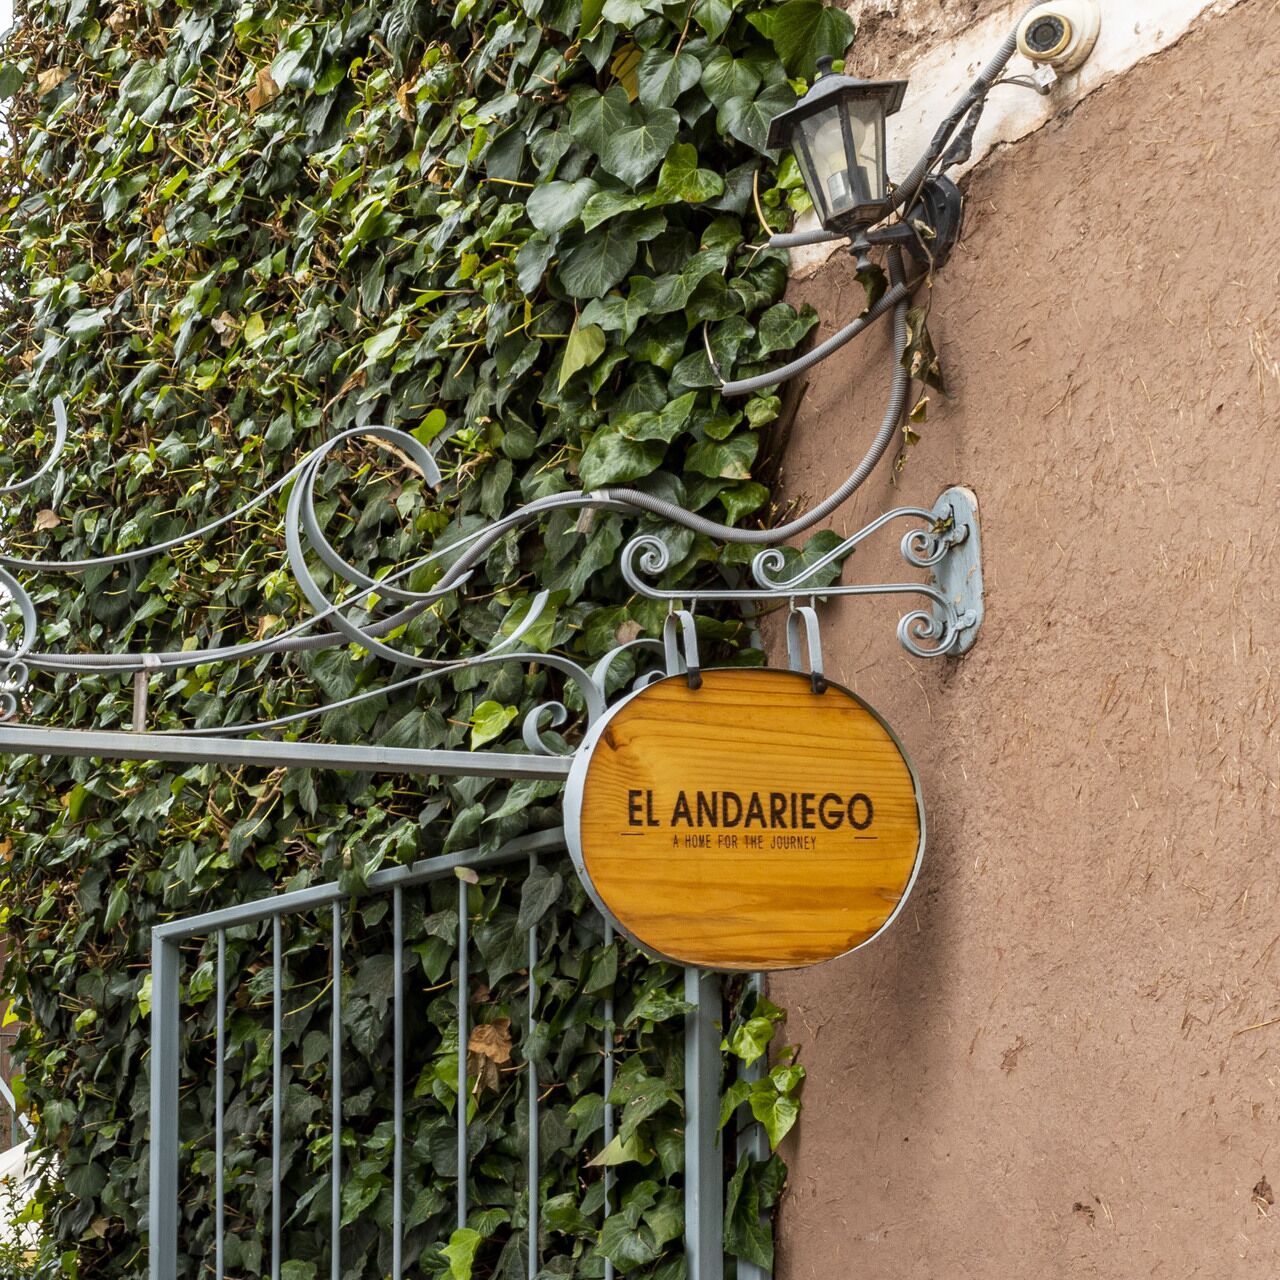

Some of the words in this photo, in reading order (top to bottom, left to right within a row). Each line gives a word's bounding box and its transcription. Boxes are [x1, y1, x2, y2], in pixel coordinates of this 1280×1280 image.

[628, 789, 660, 827] EL
[670, 790, 874, 831] ANDARIEGO
[672, 833, 680, 849] A
[685, 833, 712, 849] HOME
[717, 834, 738, 849] FOR
[744, 834, 764, 850] THE
[770, 835, 817, 850] JOURNEY
